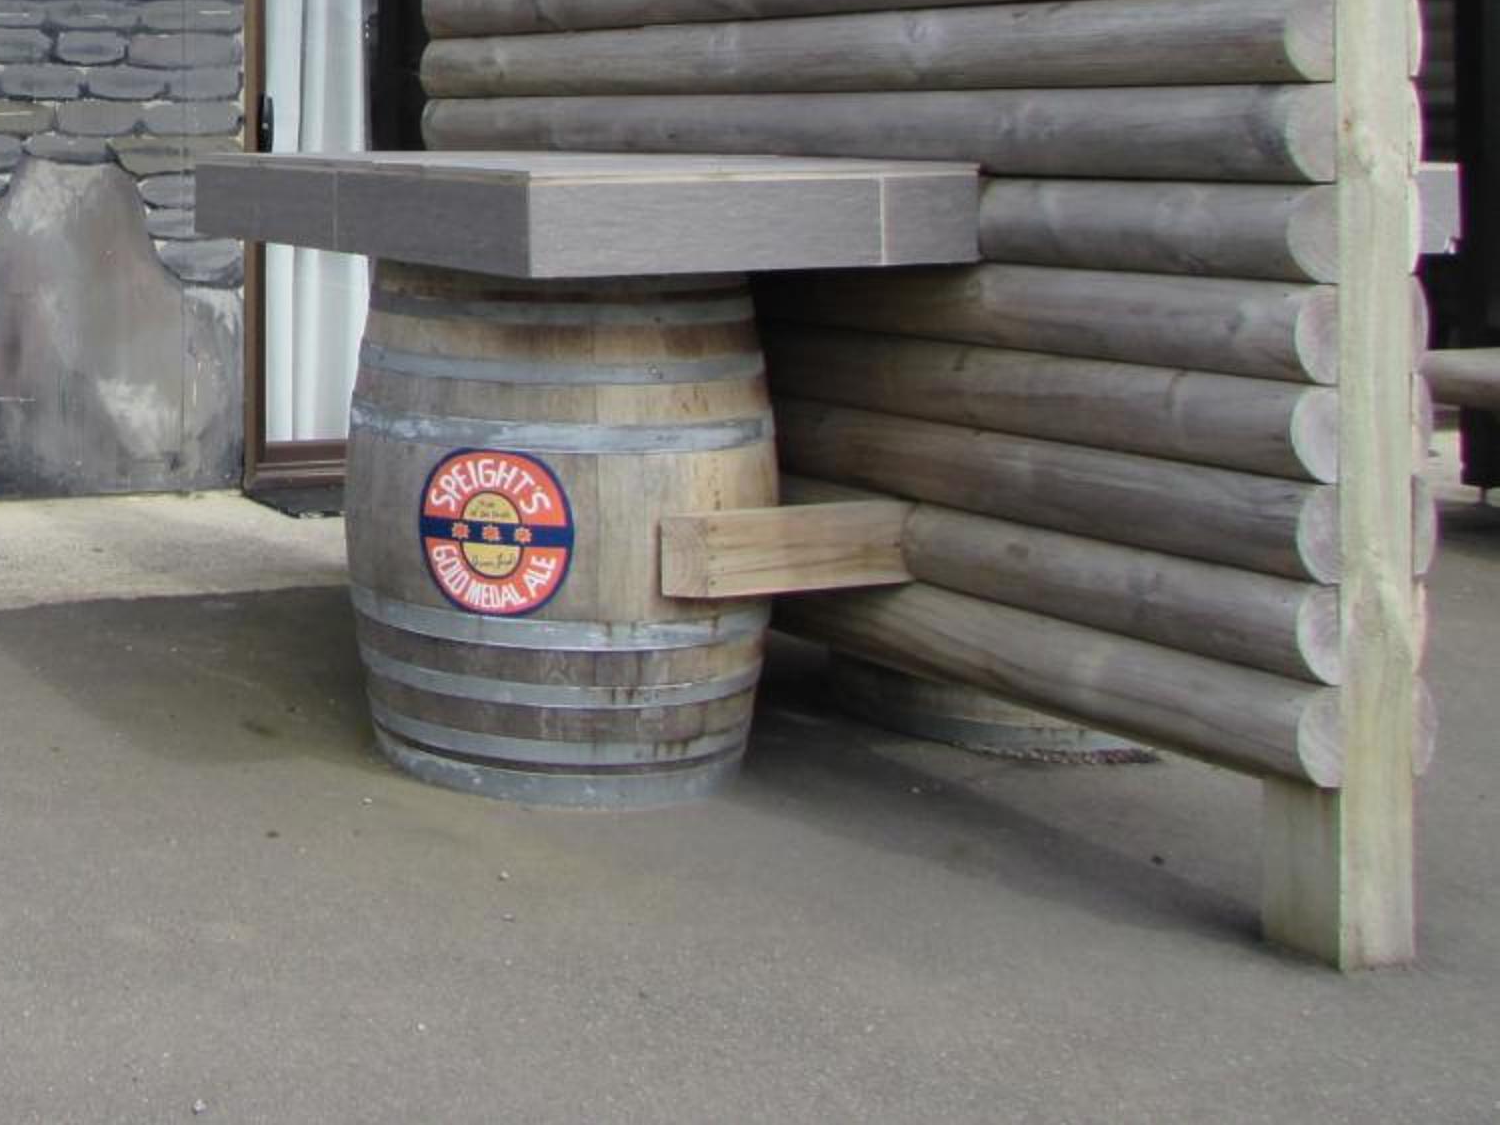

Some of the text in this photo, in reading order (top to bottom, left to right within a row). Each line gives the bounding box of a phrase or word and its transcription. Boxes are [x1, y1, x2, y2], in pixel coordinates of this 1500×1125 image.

[430, 458, 552, 515] SPEIGHT'S
[433, 544, 558, 608] GOLD MEDAL ALE
